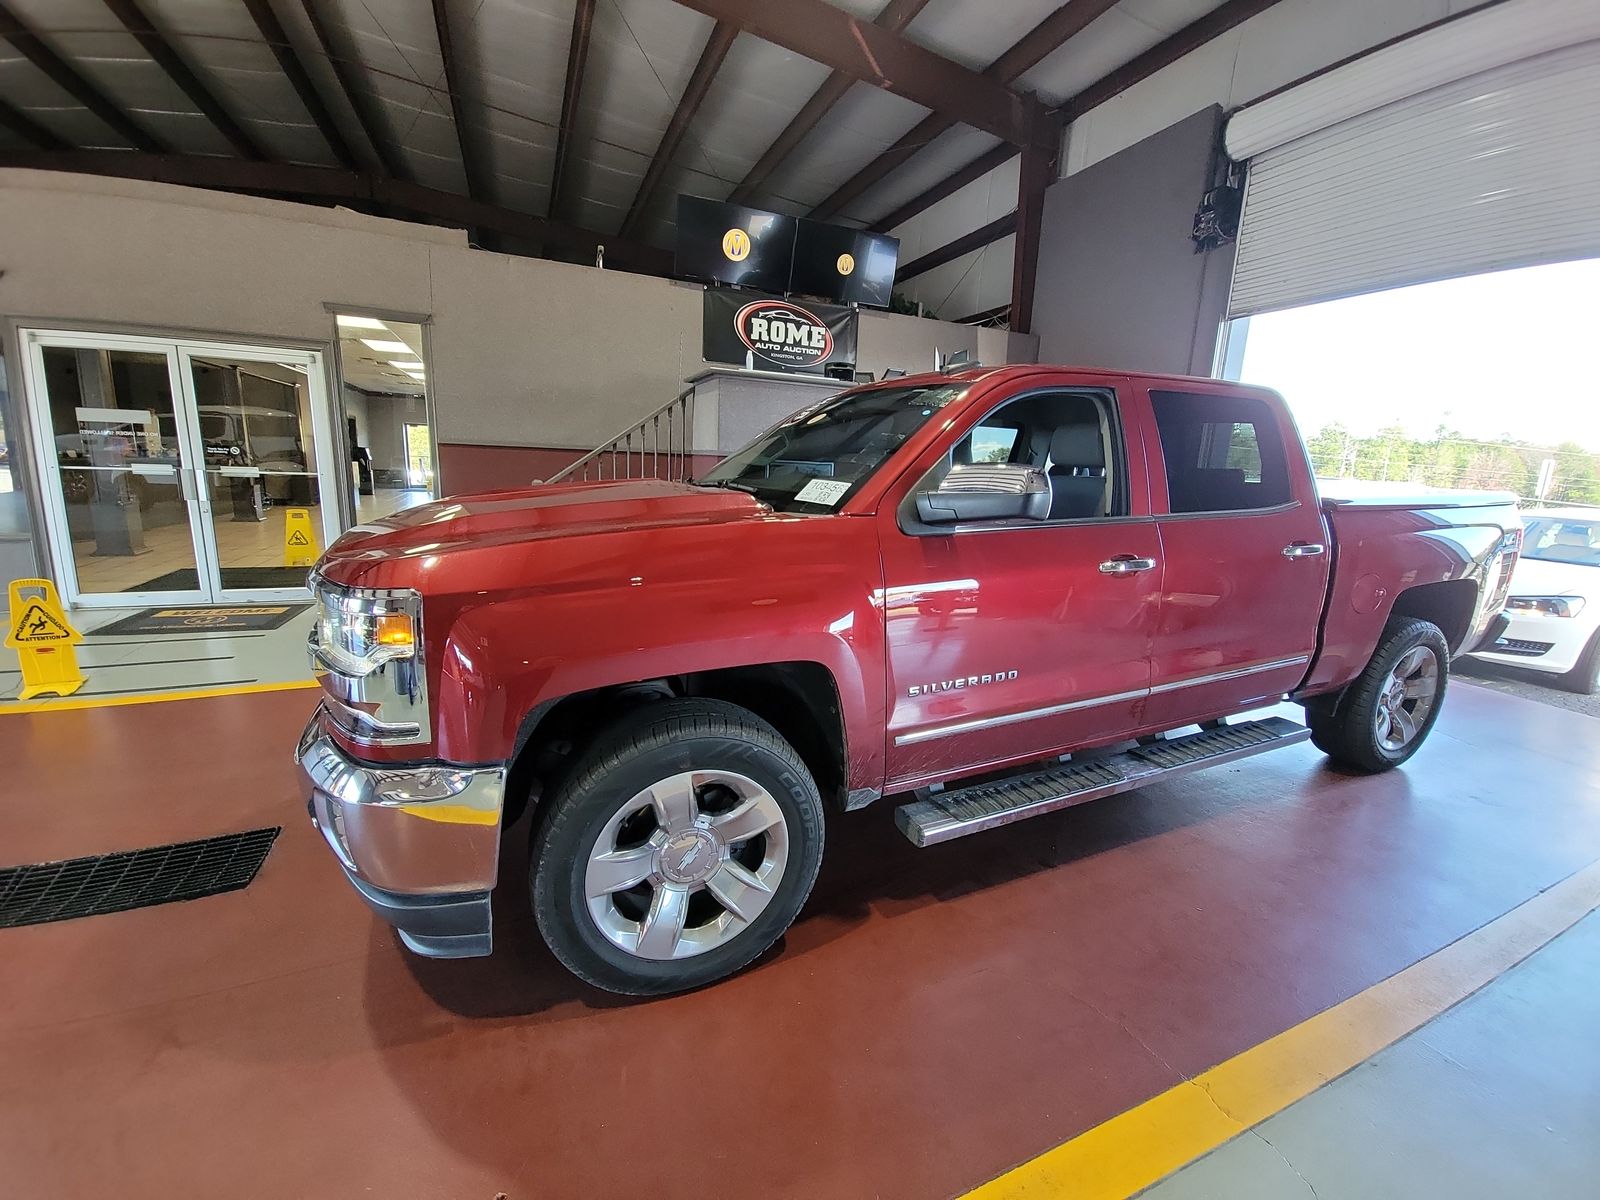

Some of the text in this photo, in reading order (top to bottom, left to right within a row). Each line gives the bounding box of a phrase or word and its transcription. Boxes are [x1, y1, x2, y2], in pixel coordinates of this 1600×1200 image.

[750, 317, 826, 348] ROME
[755, 342, 822, 356] AUTO AUCTION
[43, 611, 65, 631] CUIDADO
[173, 608, 274, 616] WELCOME
[17, 613, 32, 633] CAUTION
[908, 670, 1018, 697] SILVERADO
